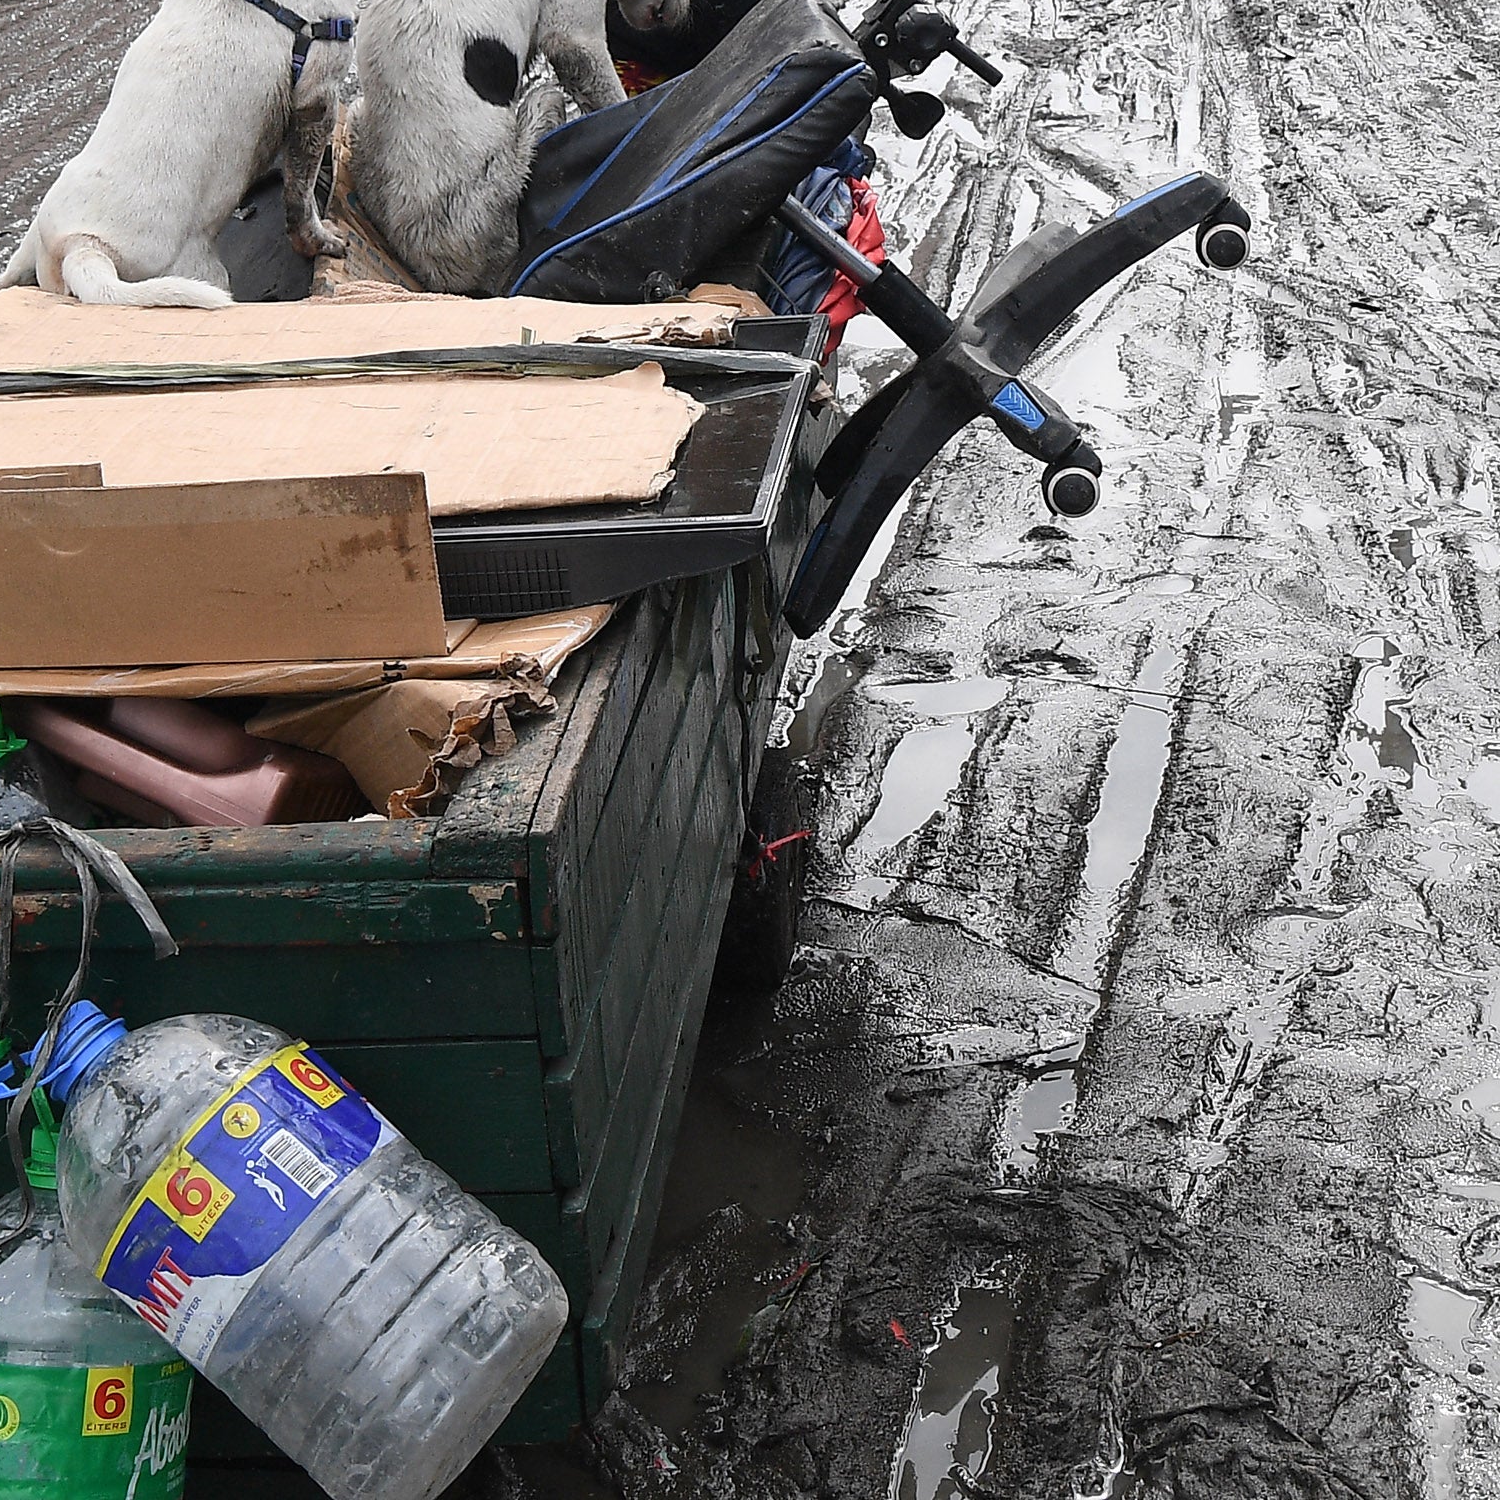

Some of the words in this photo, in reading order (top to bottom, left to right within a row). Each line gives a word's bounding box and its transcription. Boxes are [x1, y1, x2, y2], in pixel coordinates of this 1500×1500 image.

[290, 1057, 330, 1092] 6
[167, 1167, 212, 1217] 6
[193, 1191, 231, 1238] LITERS
[178, 1294, 204, 1325] WATER
[93, 1378, 125, 1419] 6
[86, 1420, 128, 1432] LITERS
